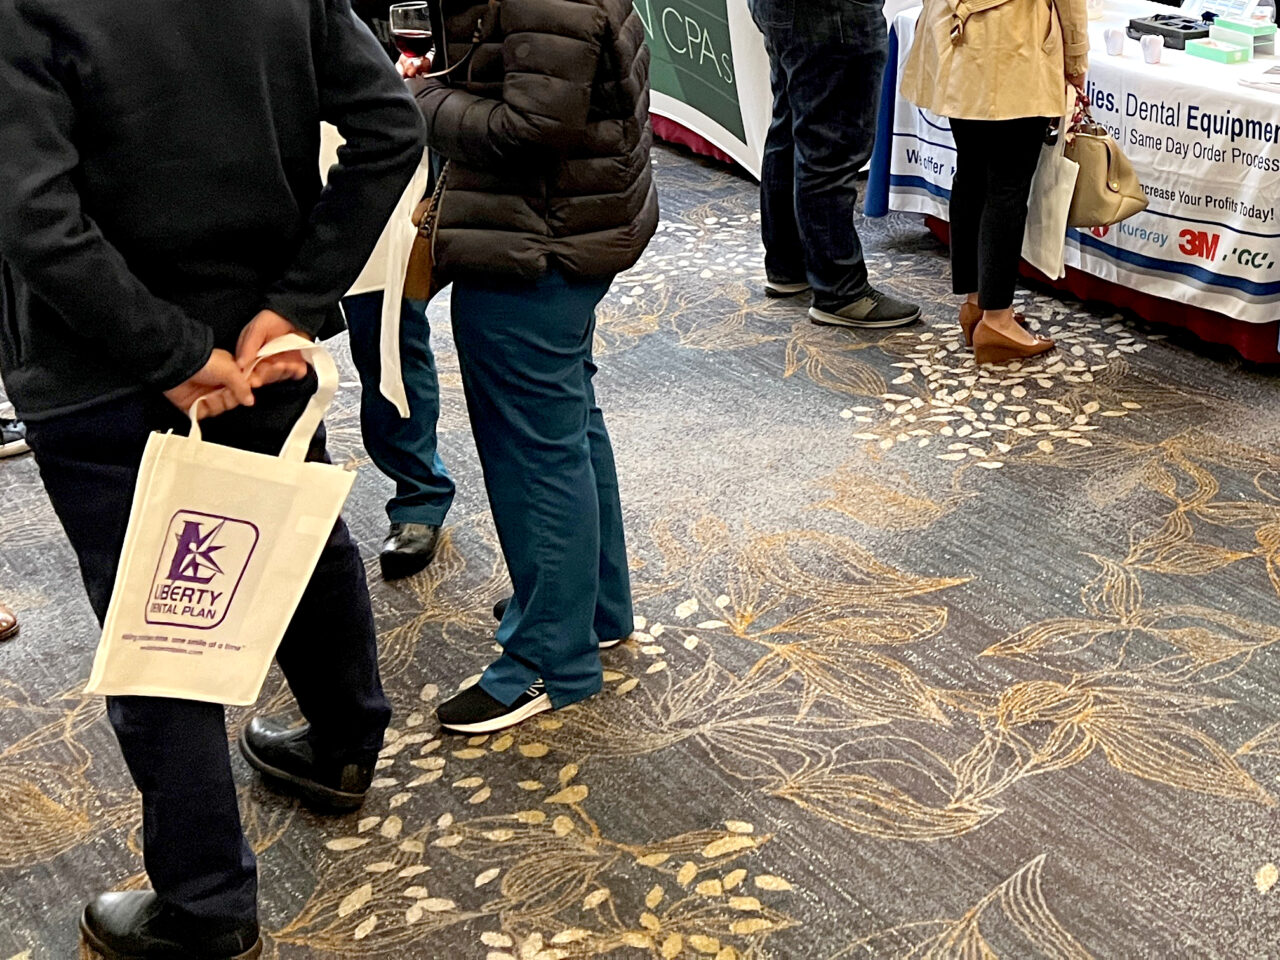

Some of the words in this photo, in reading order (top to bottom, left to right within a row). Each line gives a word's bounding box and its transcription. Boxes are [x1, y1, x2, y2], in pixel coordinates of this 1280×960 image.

[662, 7, 733, 84] CPAs
[1126, 93, 1180, 127] Dental
[1130, 128, 1162, 151] Same
[1166, 137, 1189, 159] Day
[1193, 142, 1227, 163] Order
[1179, 191, 1202, 207] Your
[1205, 196, 1238, 213] Profits
[1239, 202, 1275, 223] Today!
[1178, 228, 1221, 262] 3M
[181, 606, 217, 620] PLAN
